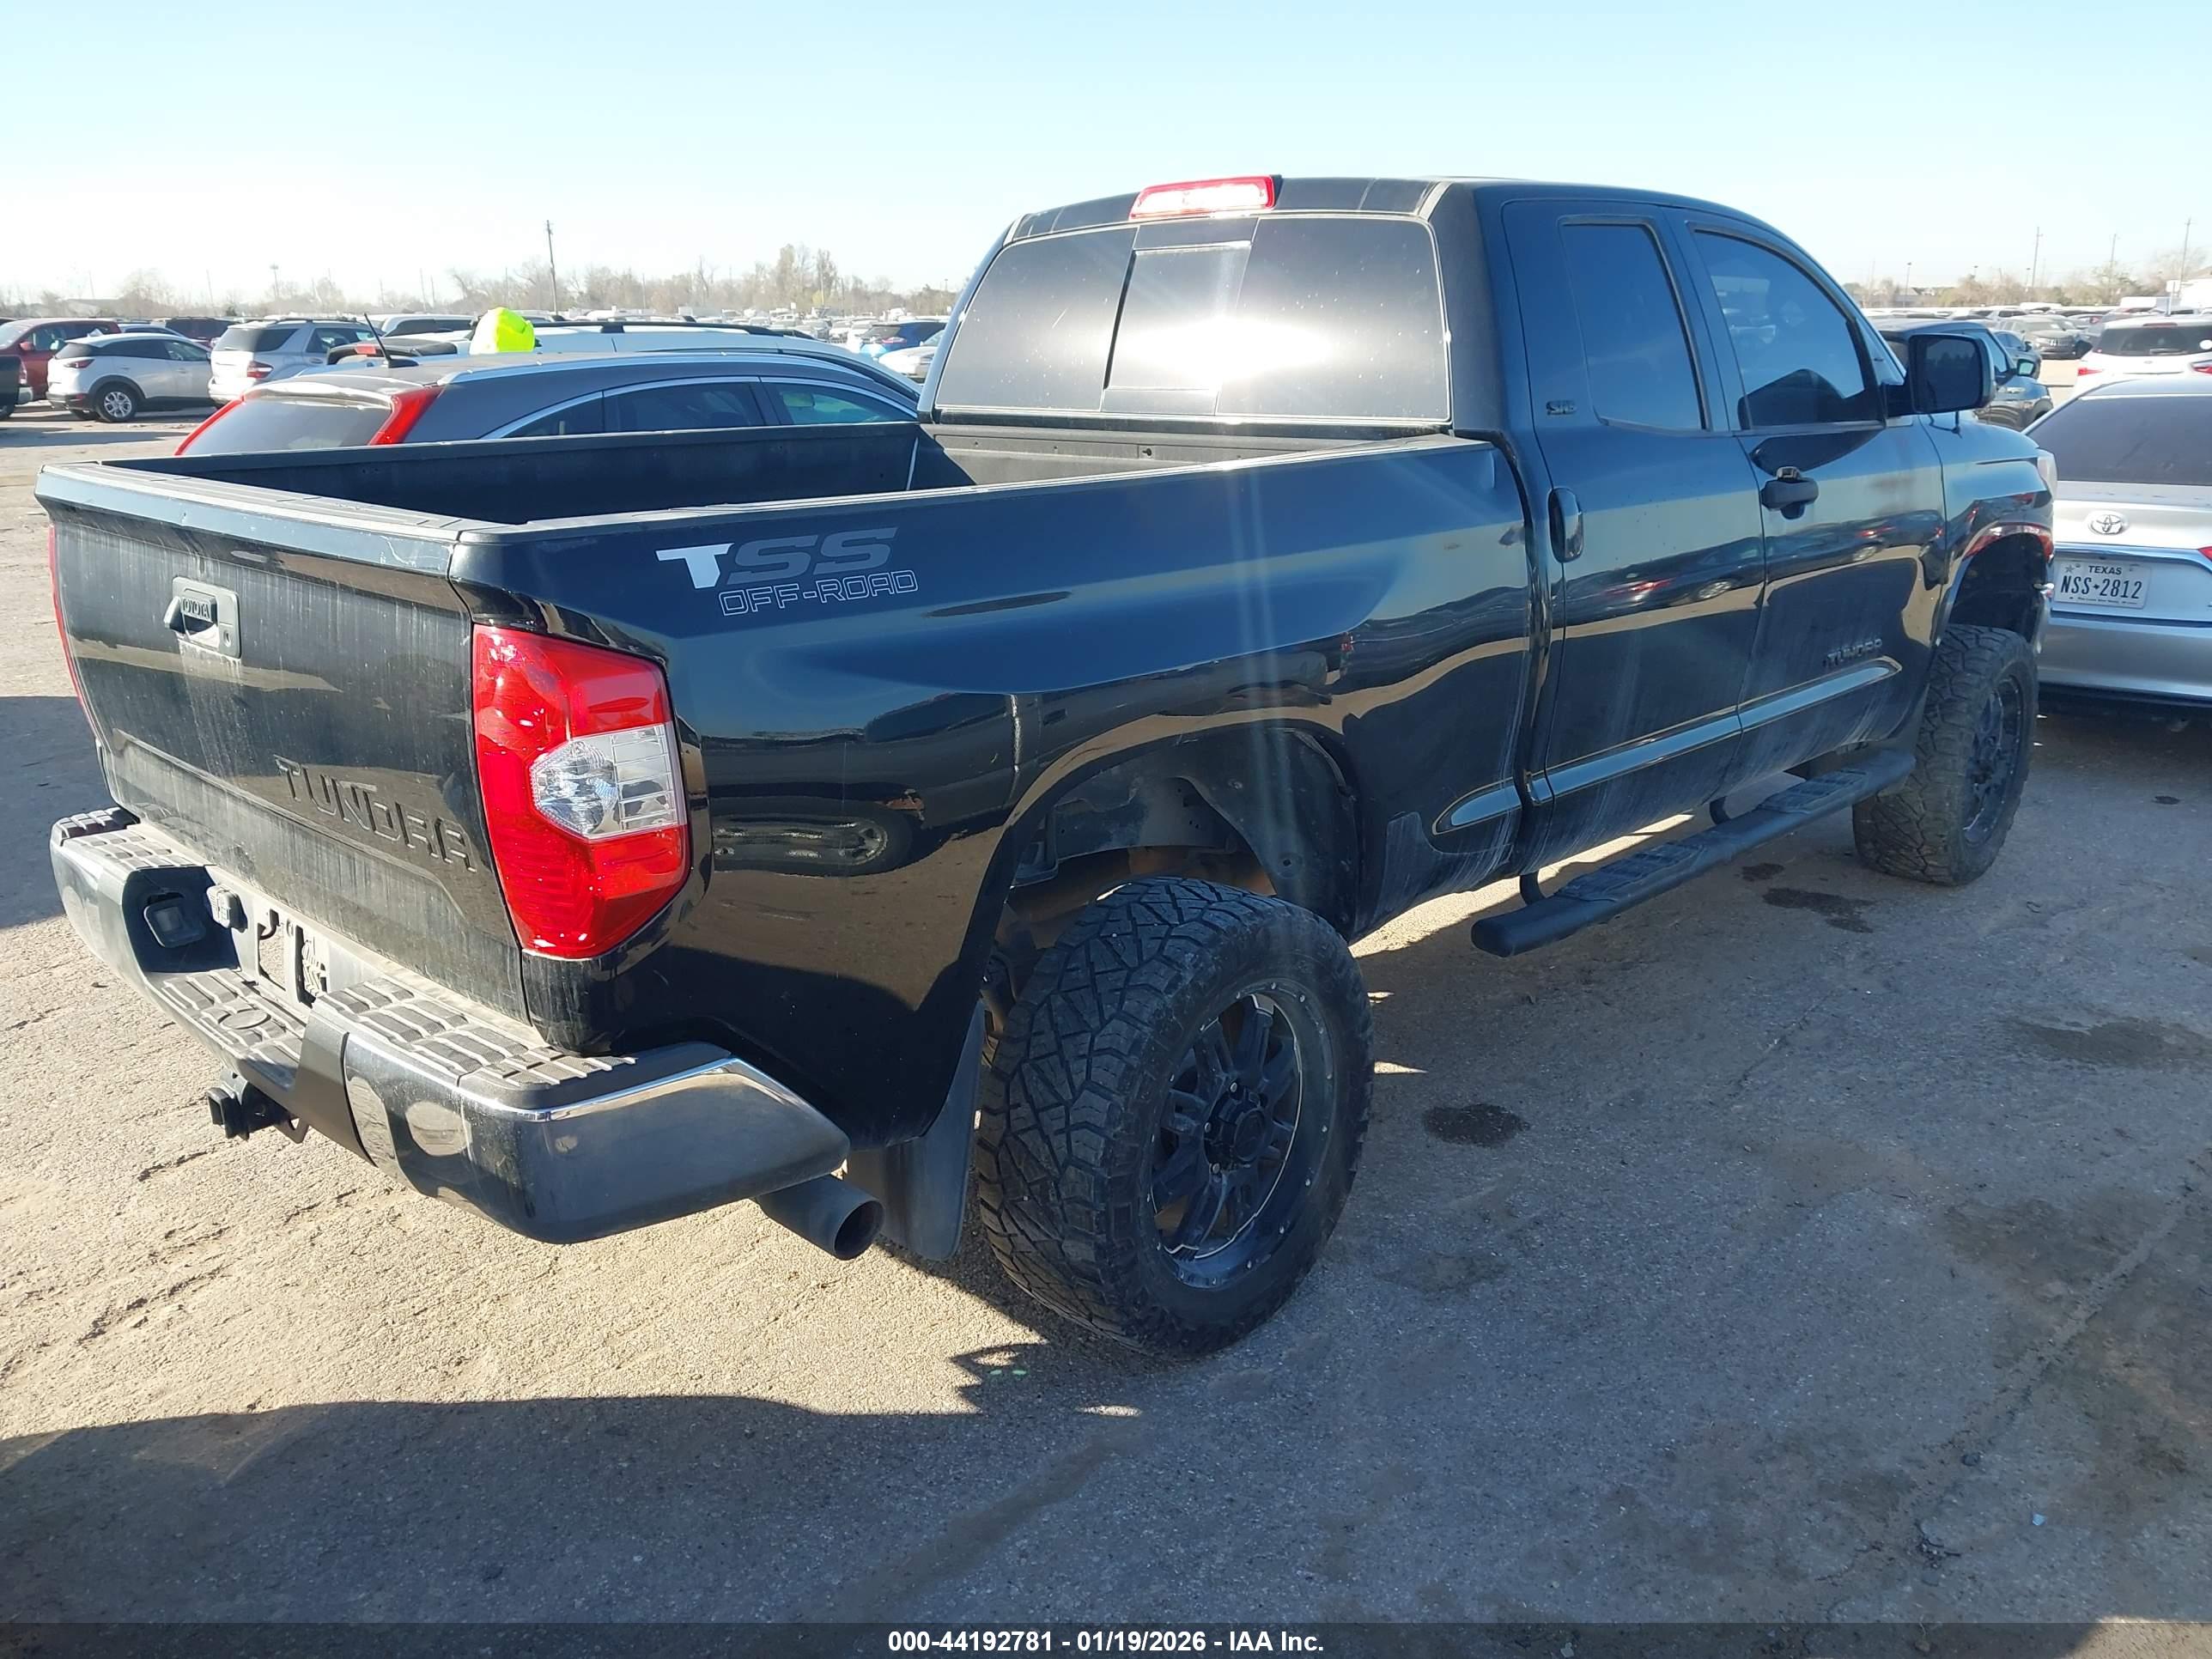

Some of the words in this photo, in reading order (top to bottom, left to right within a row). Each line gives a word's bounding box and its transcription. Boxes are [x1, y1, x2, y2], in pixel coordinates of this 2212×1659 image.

[655, 526, 899, 589] TSS
[2088, 565, 2123, 575] TEXAS
[718, 569, 918, 616] OFF-ROAD
[273, 754, 477, 872] TUNDRA
